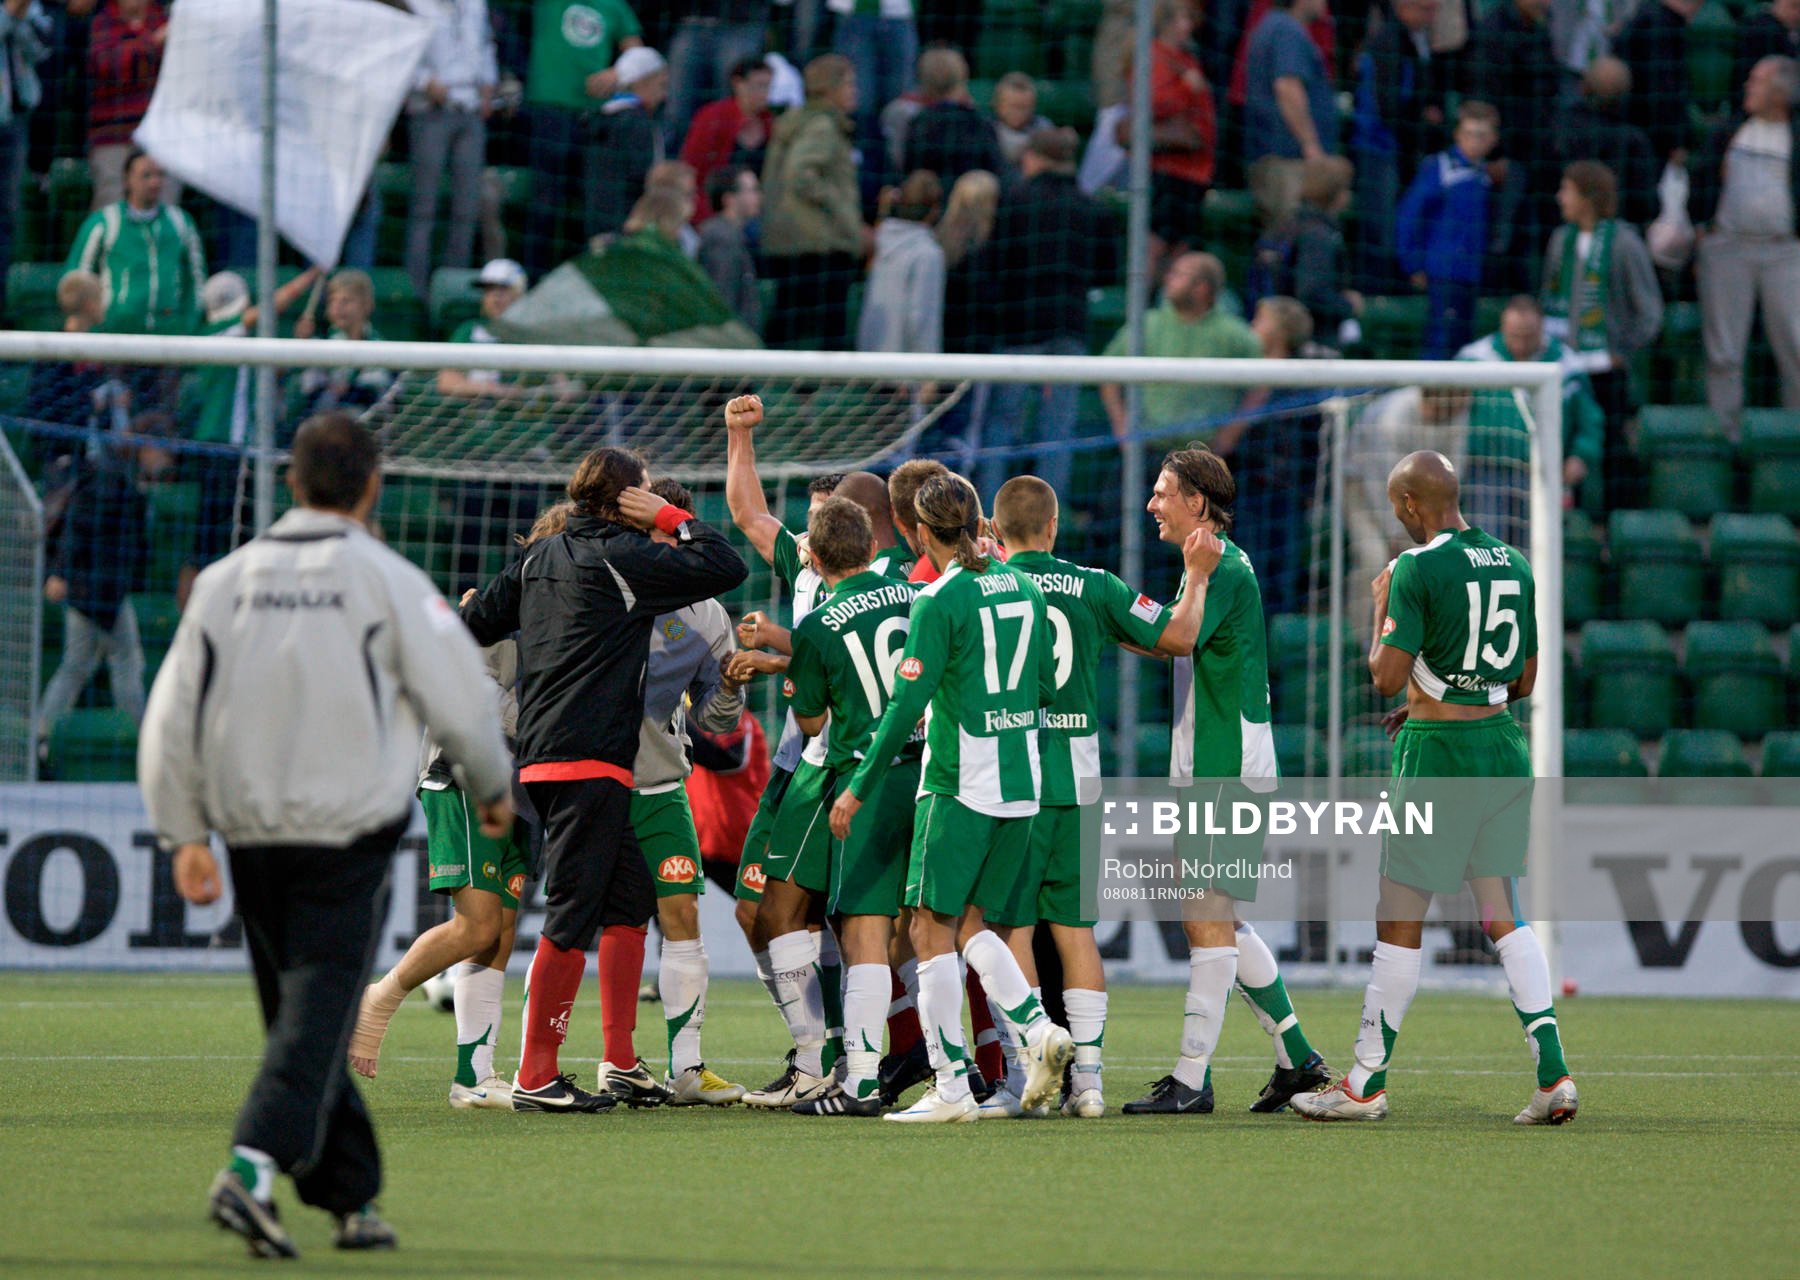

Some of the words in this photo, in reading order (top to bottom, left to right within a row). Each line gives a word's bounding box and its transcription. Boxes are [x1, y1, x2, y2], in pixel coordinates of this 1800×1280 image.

[973, 572, 1020, 597] ZENGIN
[1464, 546, 1511, 568] PAULSE
[978, 600, 1035, 695] 17
[1462, 579, 1521, 671] 15
[842, 615, 911, 719] 16
[663, 859, 695, 877] AXA
